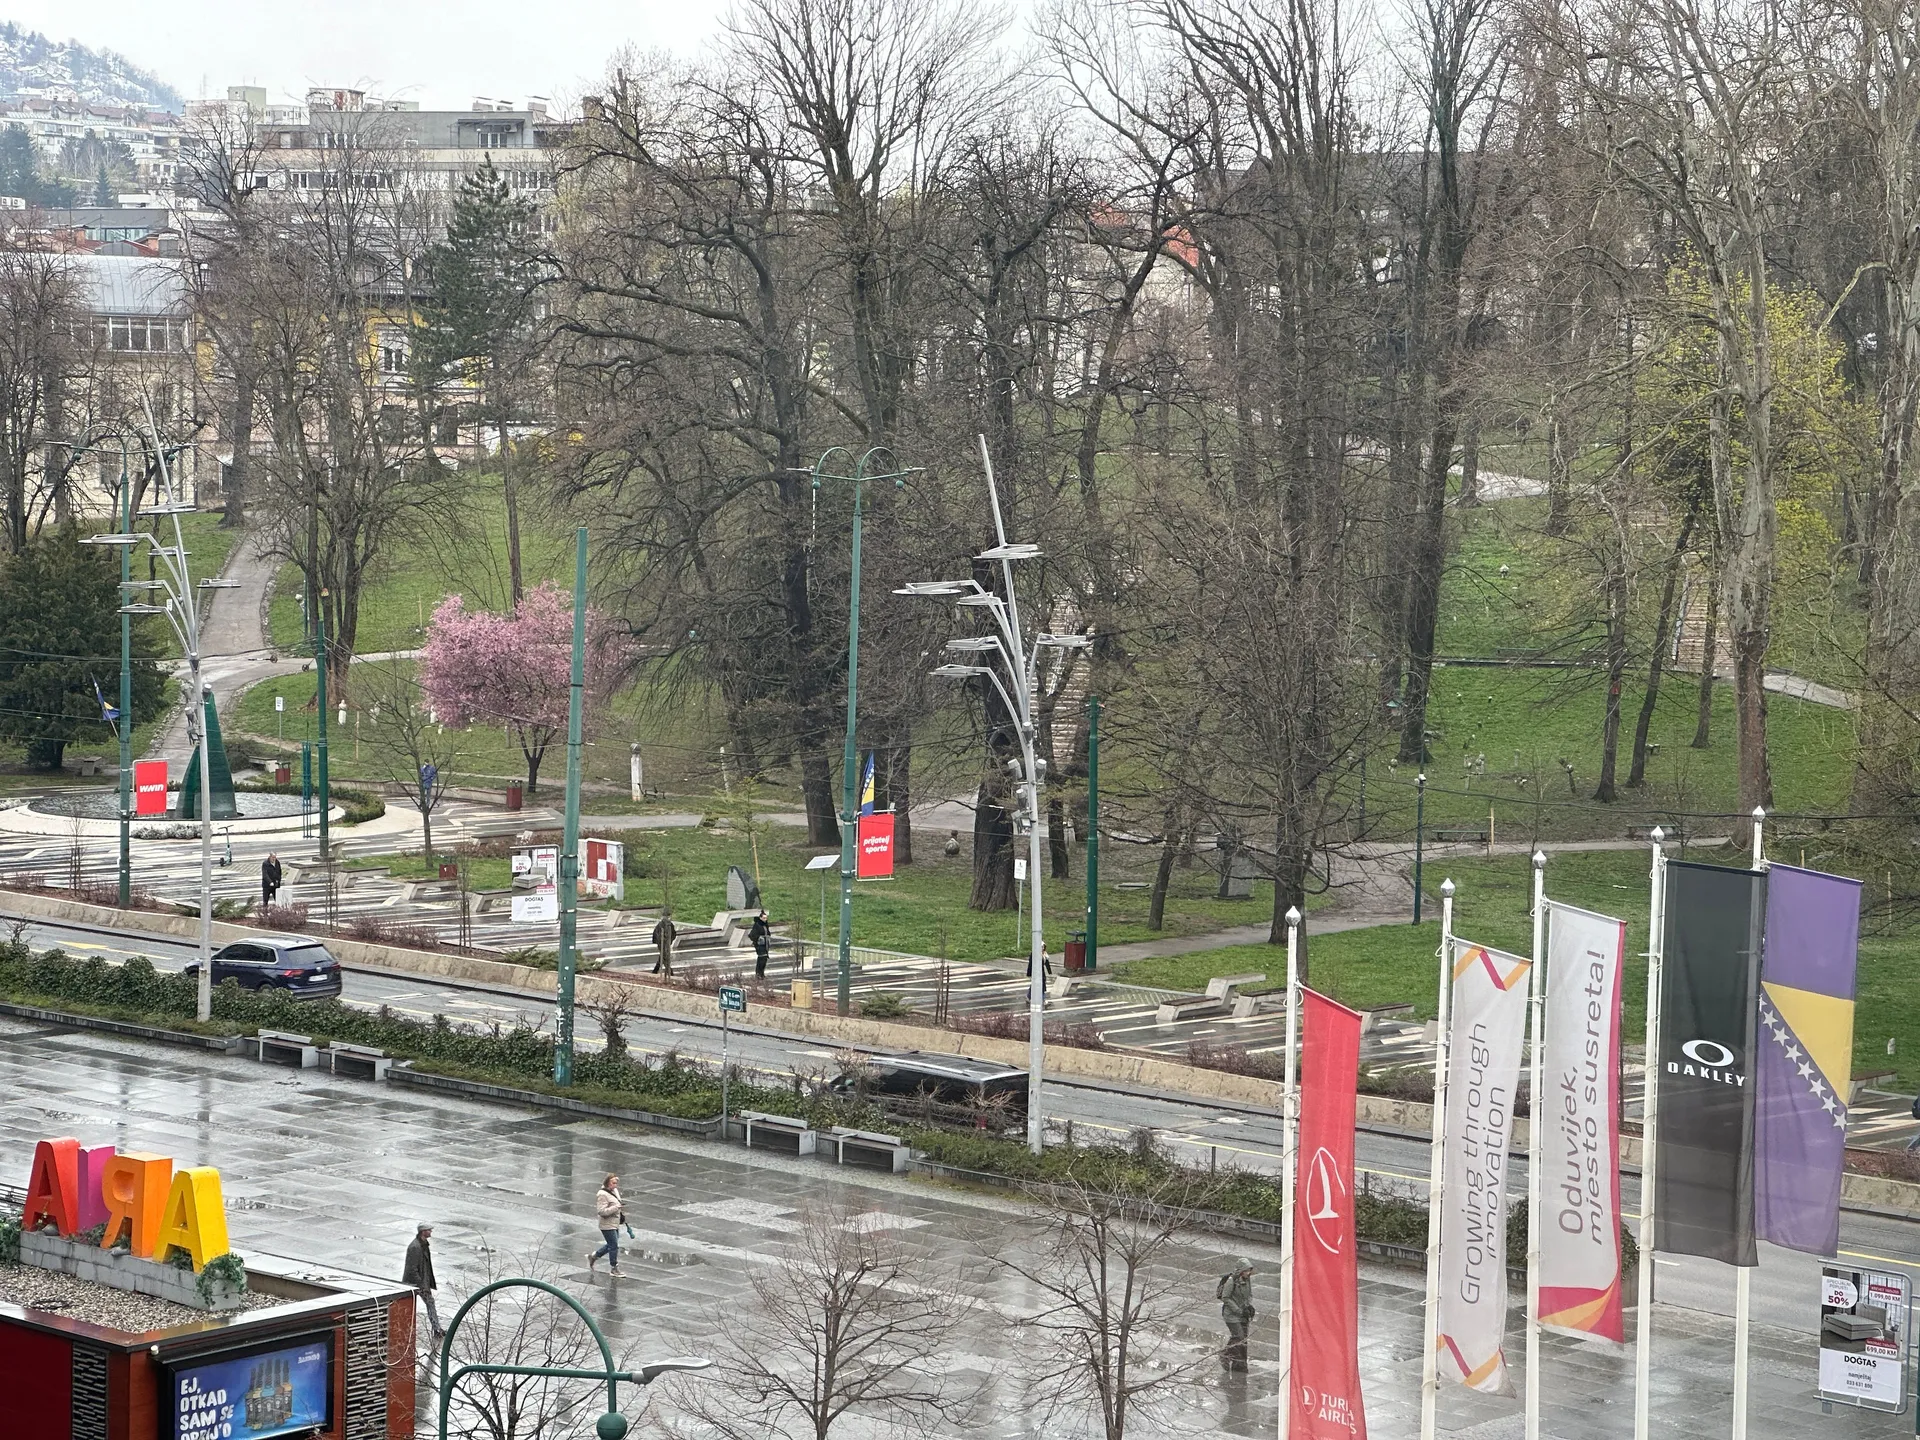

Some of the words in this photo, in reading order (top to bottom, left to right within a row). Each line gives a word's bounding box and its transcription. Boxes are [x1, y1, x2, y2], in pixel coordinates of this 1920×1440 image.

[863, 835, 890, 846] prijatelj
[865, 845, 888, 854] sporta
[1584, 950, 1606, 1105] susreta!
[1667, 1062, 1745, 1087] OAKLEY
[1462, 1023, 1489, 1158] through
[1558, 1066, 1585, 1235] Oduvijek,
[1482, 1086, 1505, 1259] innovation
[1583, 1116, 1603, 1245] mjesto
[1460, 1167, 1483, 1304] Growing
[1828, 1295, 1849, 1306] 50%
[1867, 1346, 1886, 1354] 699,00
[181, 1377, 200, 1396] EJ,
[180, 1389, 226, 1413] OTKAD
[180, 1410, 216, 1431] SAM
[220, 1404, 235, 1421] SE
